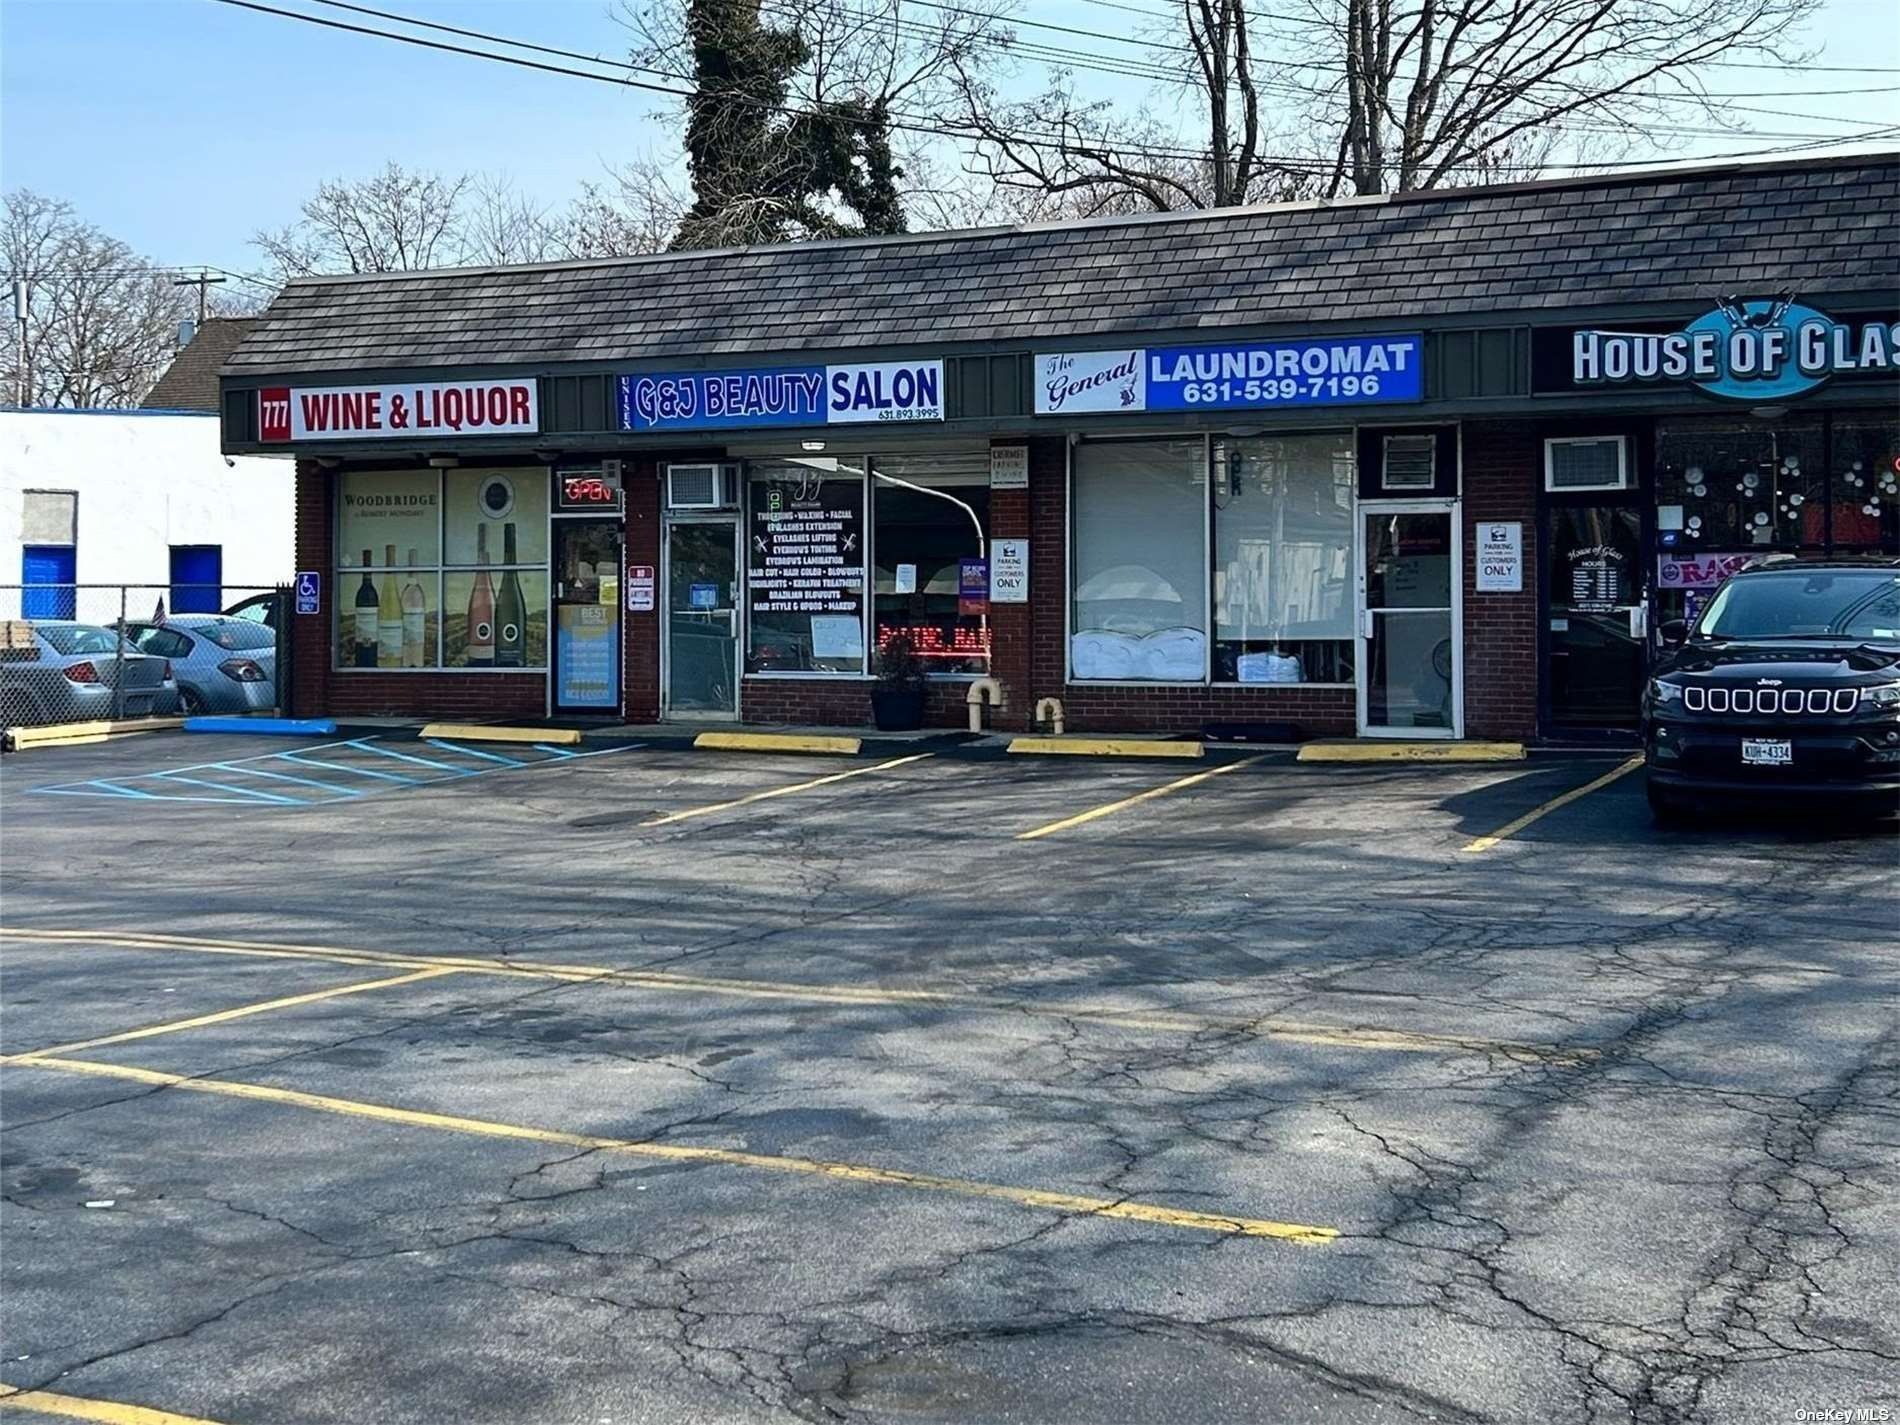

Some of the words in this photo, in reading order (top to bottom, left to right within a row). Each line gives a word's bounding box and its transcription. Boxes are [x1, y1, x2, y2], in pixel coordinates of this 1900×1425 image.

[1047, 354, 1074, 375] The
[1151, 343, 1413, 382] LAUNDROMAT
[1574, 332, 1715, 379] HOUSE
[1730, 331, 1784, 373] OF
[1046, 351, 1137, 411] General
[1183, 375, 1380, 404] 631-539-7196
[621, 376, 632, 431] UNISEX
[635, 377, 697, 427] G&J
[703, 373, 823, 416] BEAUTY
[831, 367, 938, 411] SALON
[262, 400, 289, 430] 777
[301, 392, 381, 431] WINE
[389, 393, 409, 430] &
[415, 386, 531, 432] LIQUOR
[878, 408, 940, 420] 631.893.3995
[344, 493, 438, 507] WOODBRIDGE
[566, 480, 611, 500] OPEN
[830, 510, 853, 519] FACIAL
[1484, 565, 1513, 576] ONLY
[997, 578, 1021, 588] ONLY
[582, 607, 607, 618] BEST
[771, 602, 791, 610] STYLE
[1757, 678, 1782, 686] Jeep
